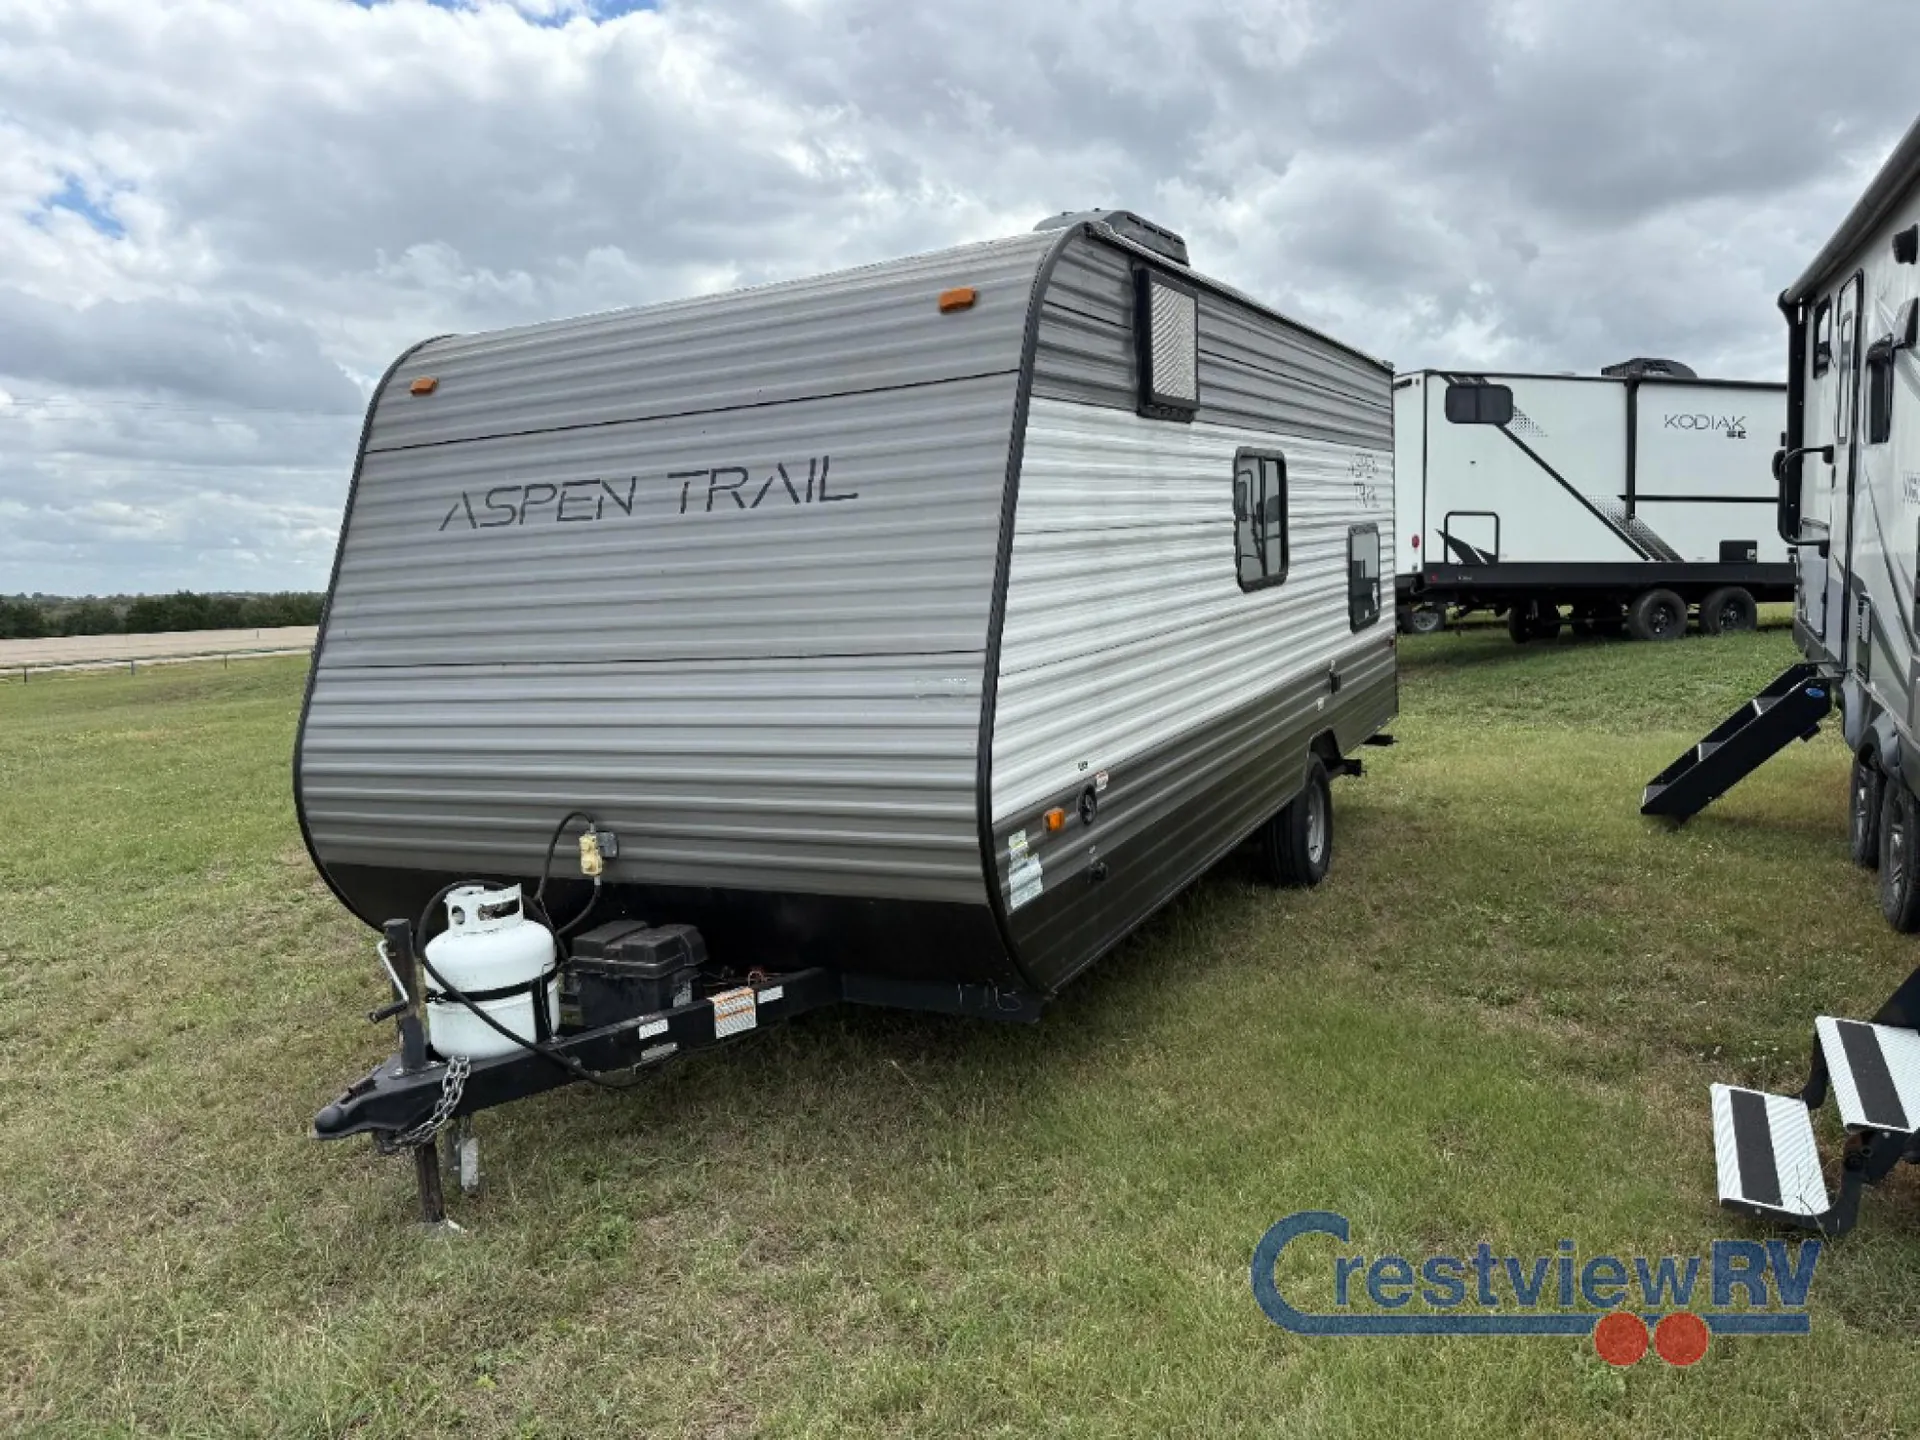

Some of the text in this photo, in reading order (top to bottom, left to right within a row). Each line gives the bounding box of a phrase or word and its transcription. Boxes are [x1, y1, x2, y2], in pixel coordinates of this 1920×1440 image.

[1664, 414, 1747, 430] KODIAK
[439, 455, 859, 531] ASPEN TRAIL
